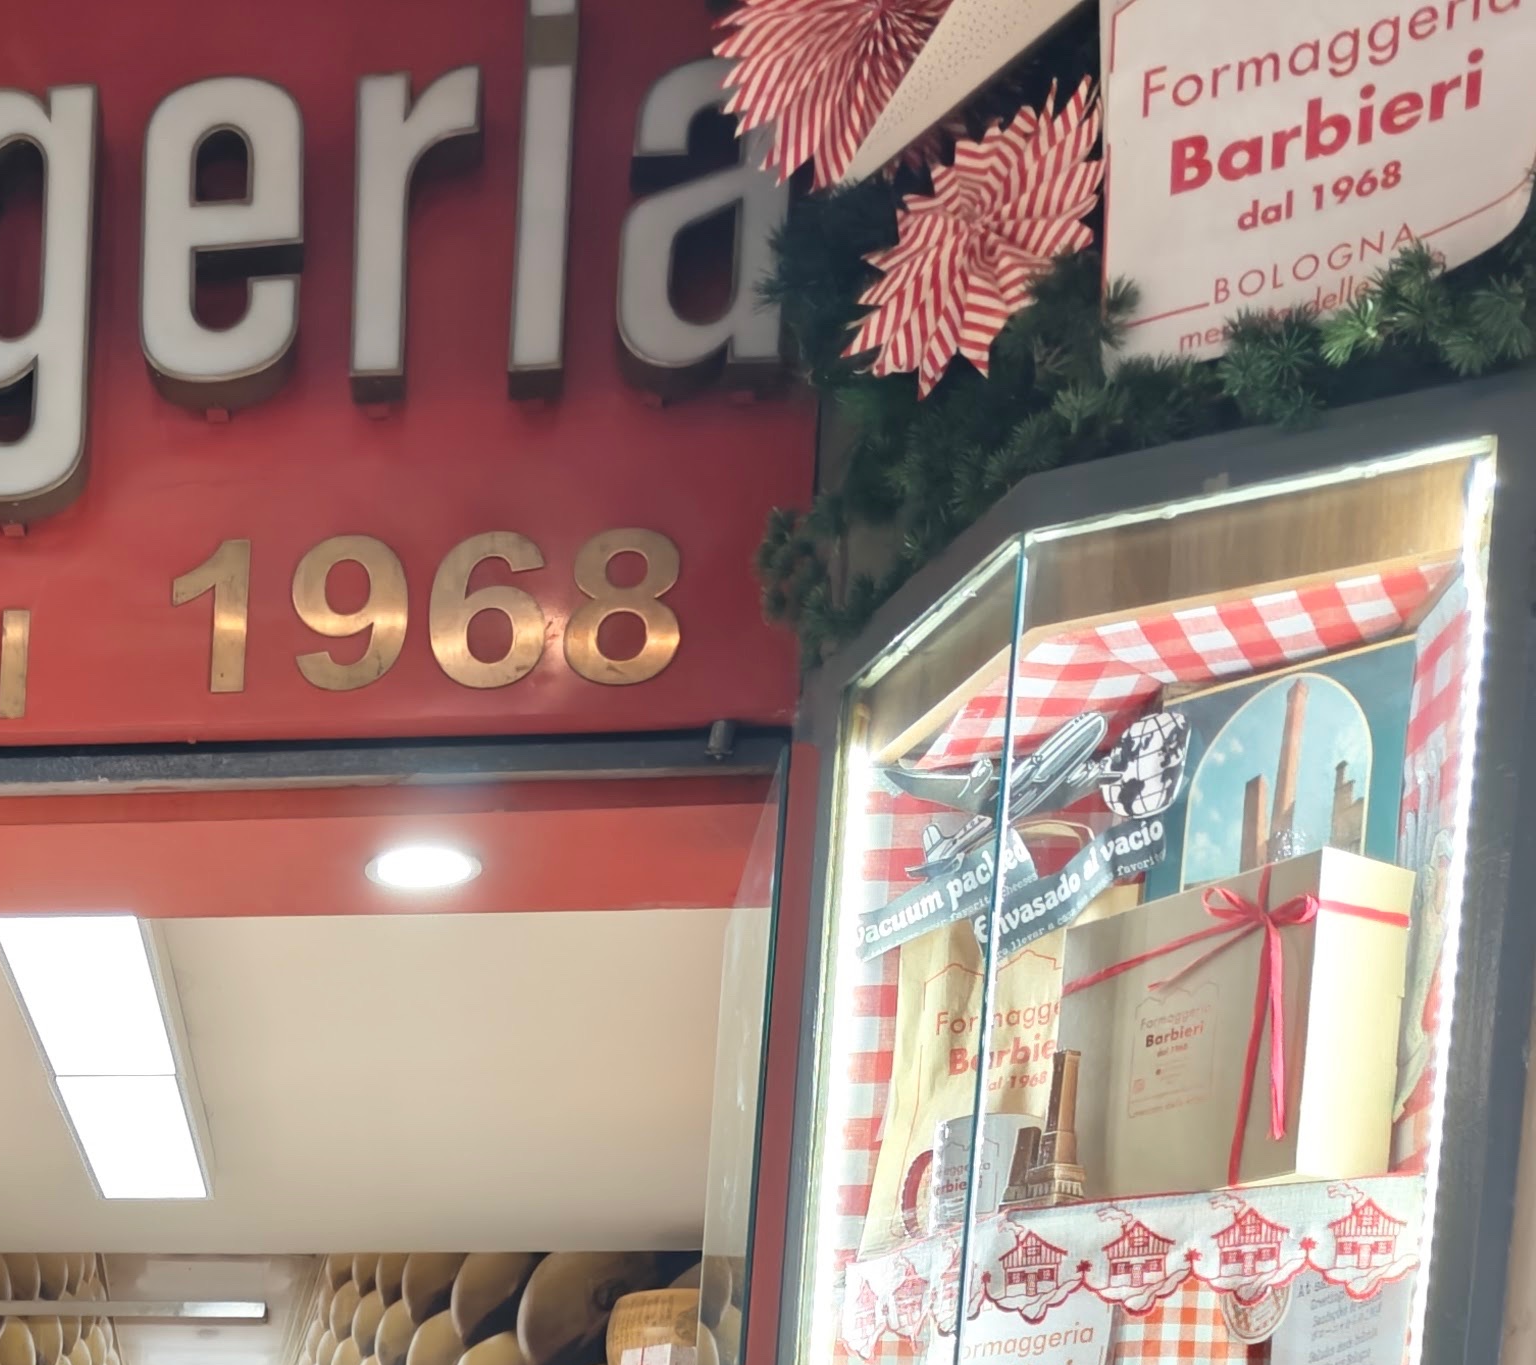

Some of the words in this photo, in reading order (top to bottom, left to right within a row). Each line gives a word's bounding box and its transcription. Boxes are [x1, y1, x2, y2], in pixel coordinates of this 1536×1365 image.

[1169, 49, 1484, 196] Barbieri
[1237, 184, 1293, 231] dal
[1312, 160, 1403, 212] 1968
[1214, 223, 1414, 304] BOLOGNA
[170, 527, 682, 697] 1968
[937, 1000, 1062, 1035] Foragge
[1145, 1022, 1204, 1049] Barbieri
[949, 1033, 1058, 1077] Brbie
[1009, 1071, 1048, 1091] 1968
[963, 1322, 1095, 1360] ormaggeria
